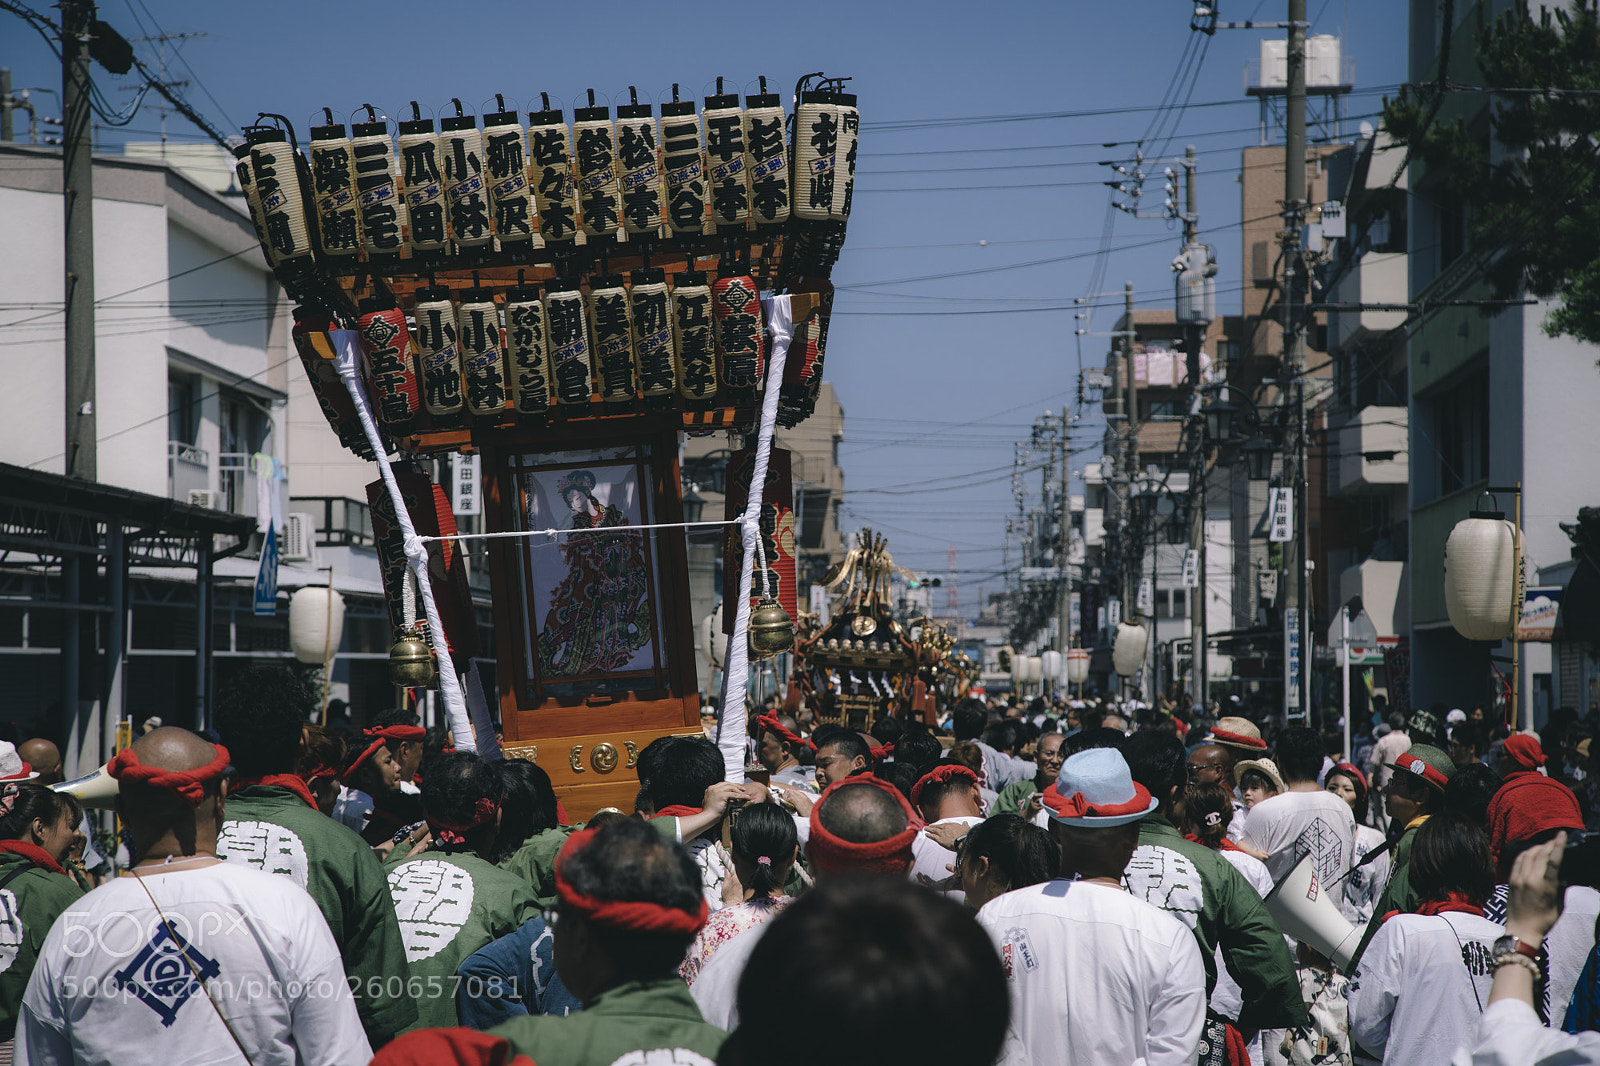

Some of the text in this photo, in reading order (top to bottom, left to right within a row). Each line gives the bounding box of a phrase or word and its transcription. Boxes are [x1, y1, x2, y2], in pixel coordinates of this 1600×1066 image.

[403, 141, 444, 242] 瓜田
[445, 138, 489, 239] 小林
[533, 129, 575, 239] 佐々木
[619, 123, 660, 229] 松本
[708, 115, 747, 222] 平本
[748, 116, 788, 220] 杉本
[420, 310, 462, 407] 小池
[462, 310, 505, 409] 小林
[511, 305, 548, 412] なかむら屋
[677, 294, 714, 397] 江美子
